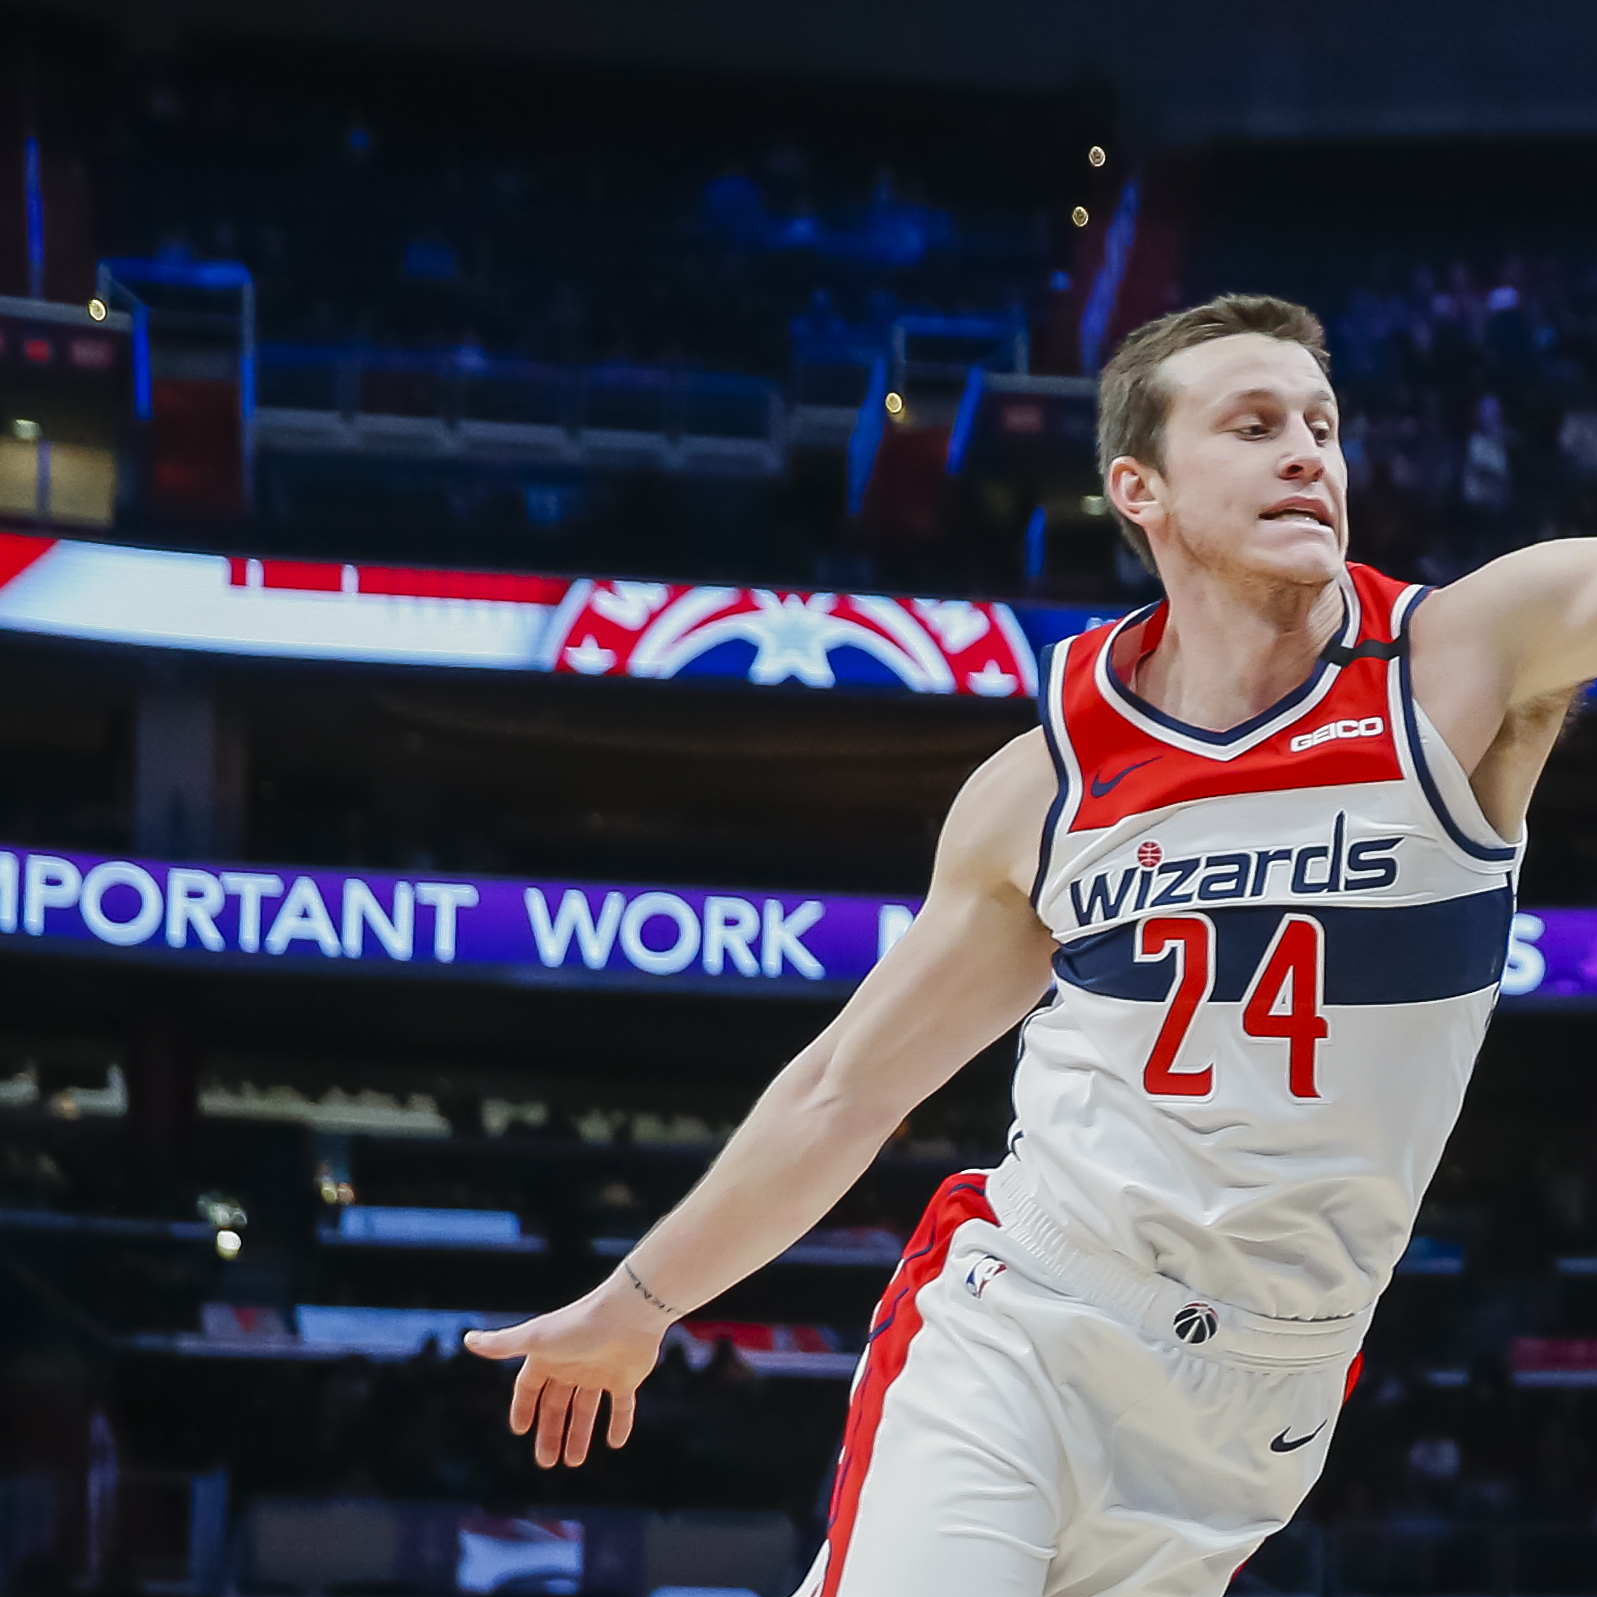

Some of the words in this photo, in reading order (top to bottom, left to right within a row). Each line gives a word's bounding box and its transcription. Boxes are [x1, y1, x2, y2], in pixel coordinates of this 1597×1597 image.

[1290, 716, 1384, 752] GEICO
[1070, 812, 1405, 928] wizards
[523, 886, 826, 981] WORK
[1136, 914, 1331, 1101] 24
